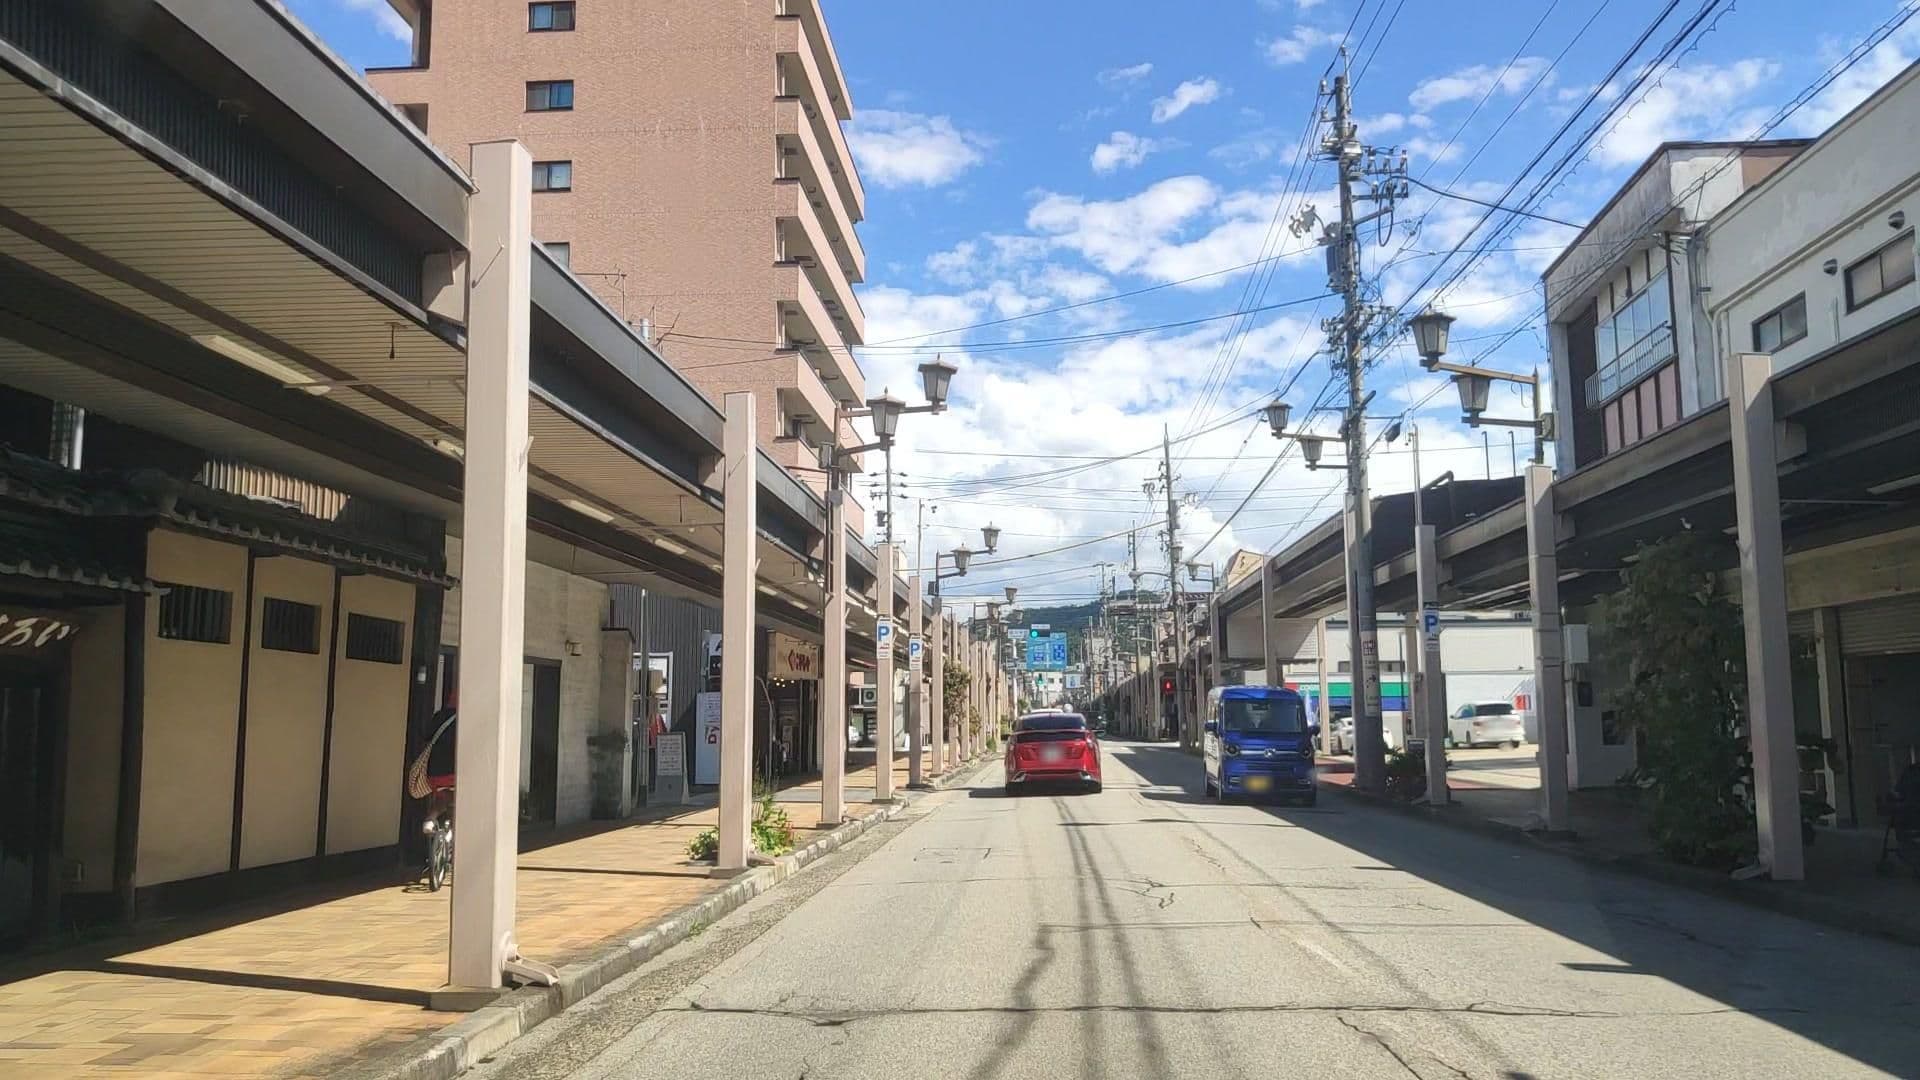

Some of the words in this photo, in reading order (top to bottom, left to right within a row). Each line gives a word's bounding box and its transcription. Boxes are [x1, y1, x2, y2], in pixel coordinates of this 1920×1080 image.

[1425, 615, 1438, 632] P
[878, 625, 890, 641] P
[910, 642, 920, 656] P
